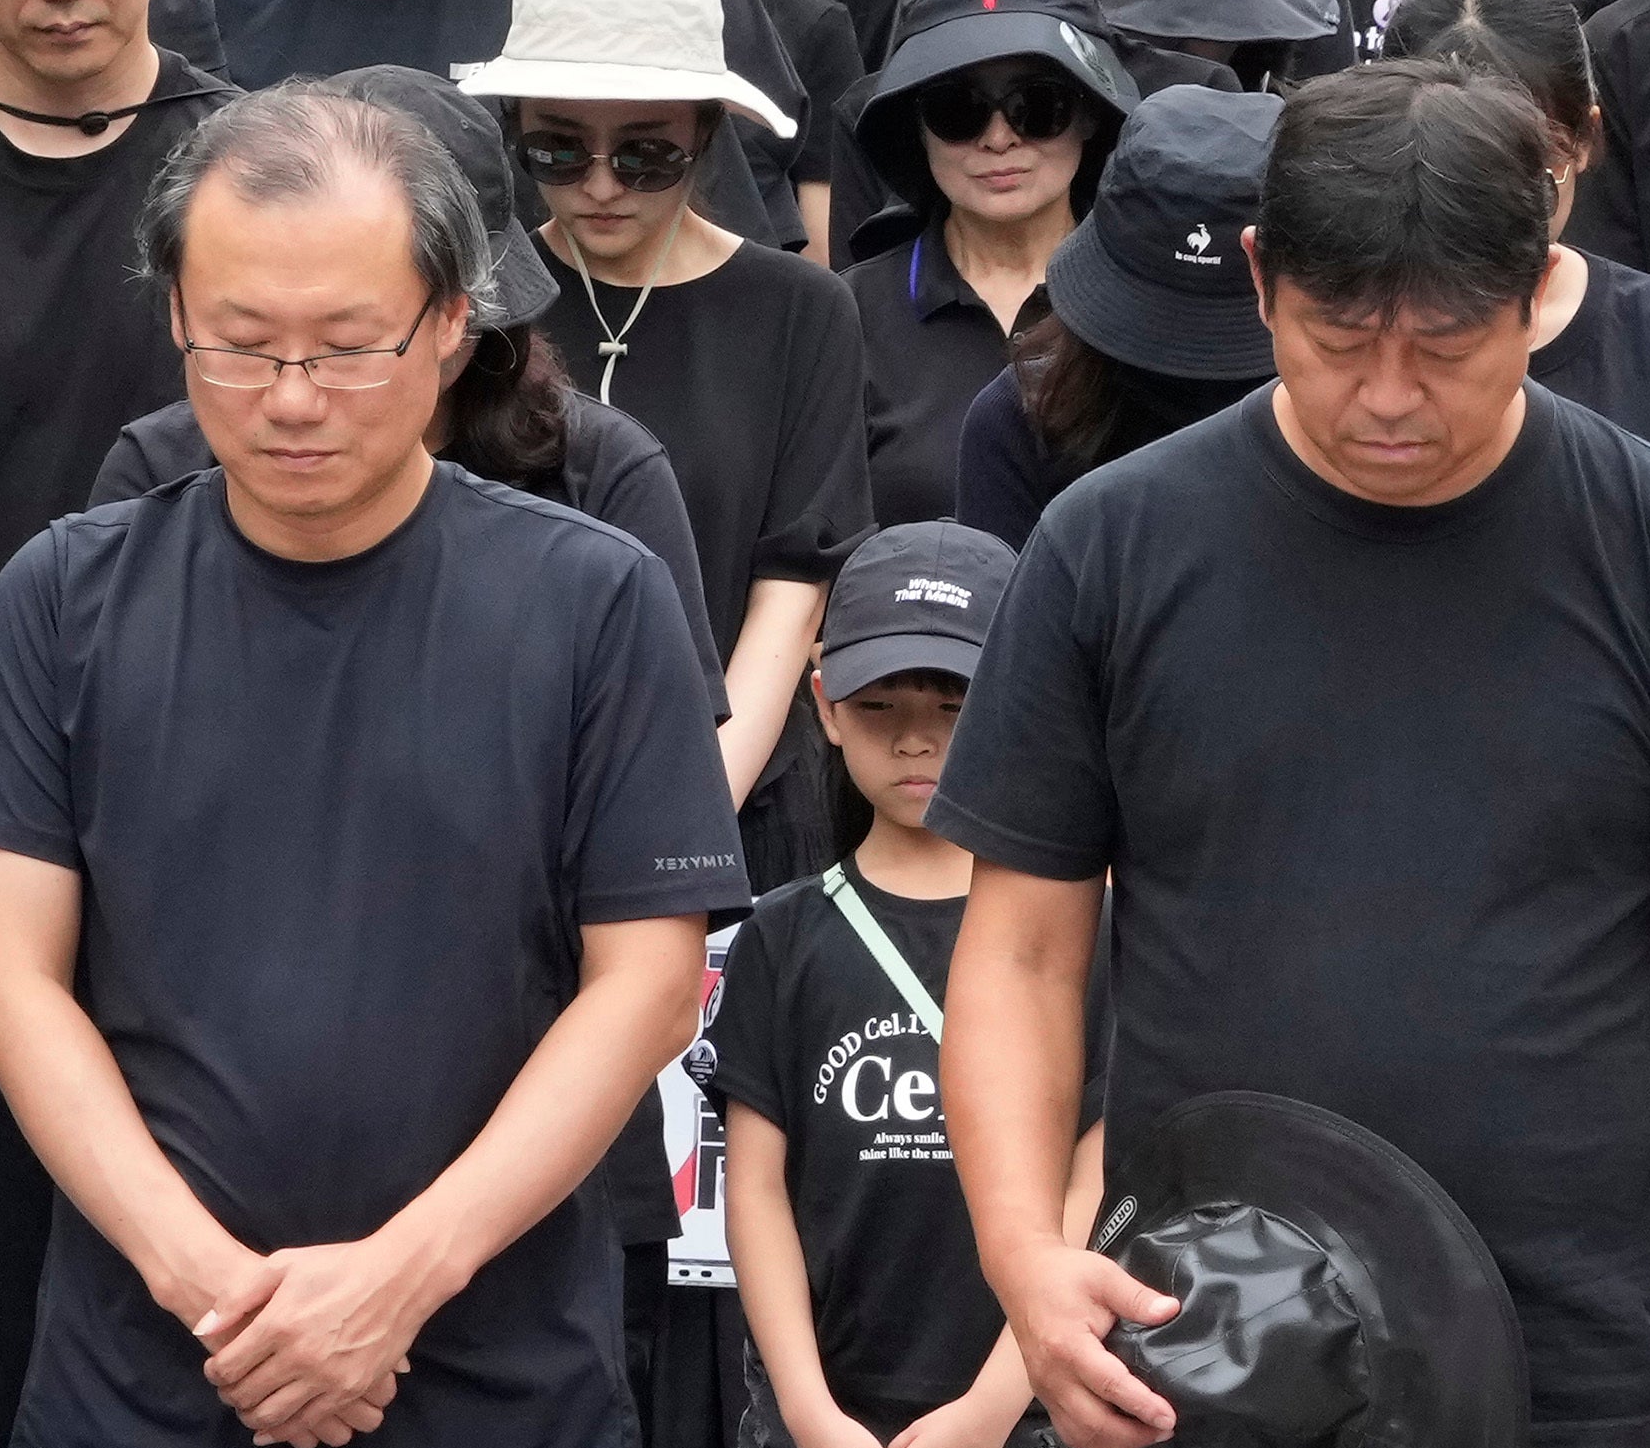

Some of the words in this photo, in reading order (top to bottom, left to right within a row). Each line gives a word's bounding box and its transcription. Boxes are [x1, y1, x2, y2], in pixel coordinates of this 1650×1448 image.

[908, 576, 973, 599] Whatever
[895, 589, 924, 603] That
[924, 590, 969, 609] Means
[654, 853, 737, 871] XEXYMIX
[813, 1032, 862, 1104] GOOD
[864, 1012, 930, 1040] Cel.1
[873, 1132, 912, 1145] Always
[913, 1132, 946, 1144] smile
[859, 1148, 887, 1161] Shine
[888, 1147, 911, 1159] like
[911, 1148, 931, 1159] the
